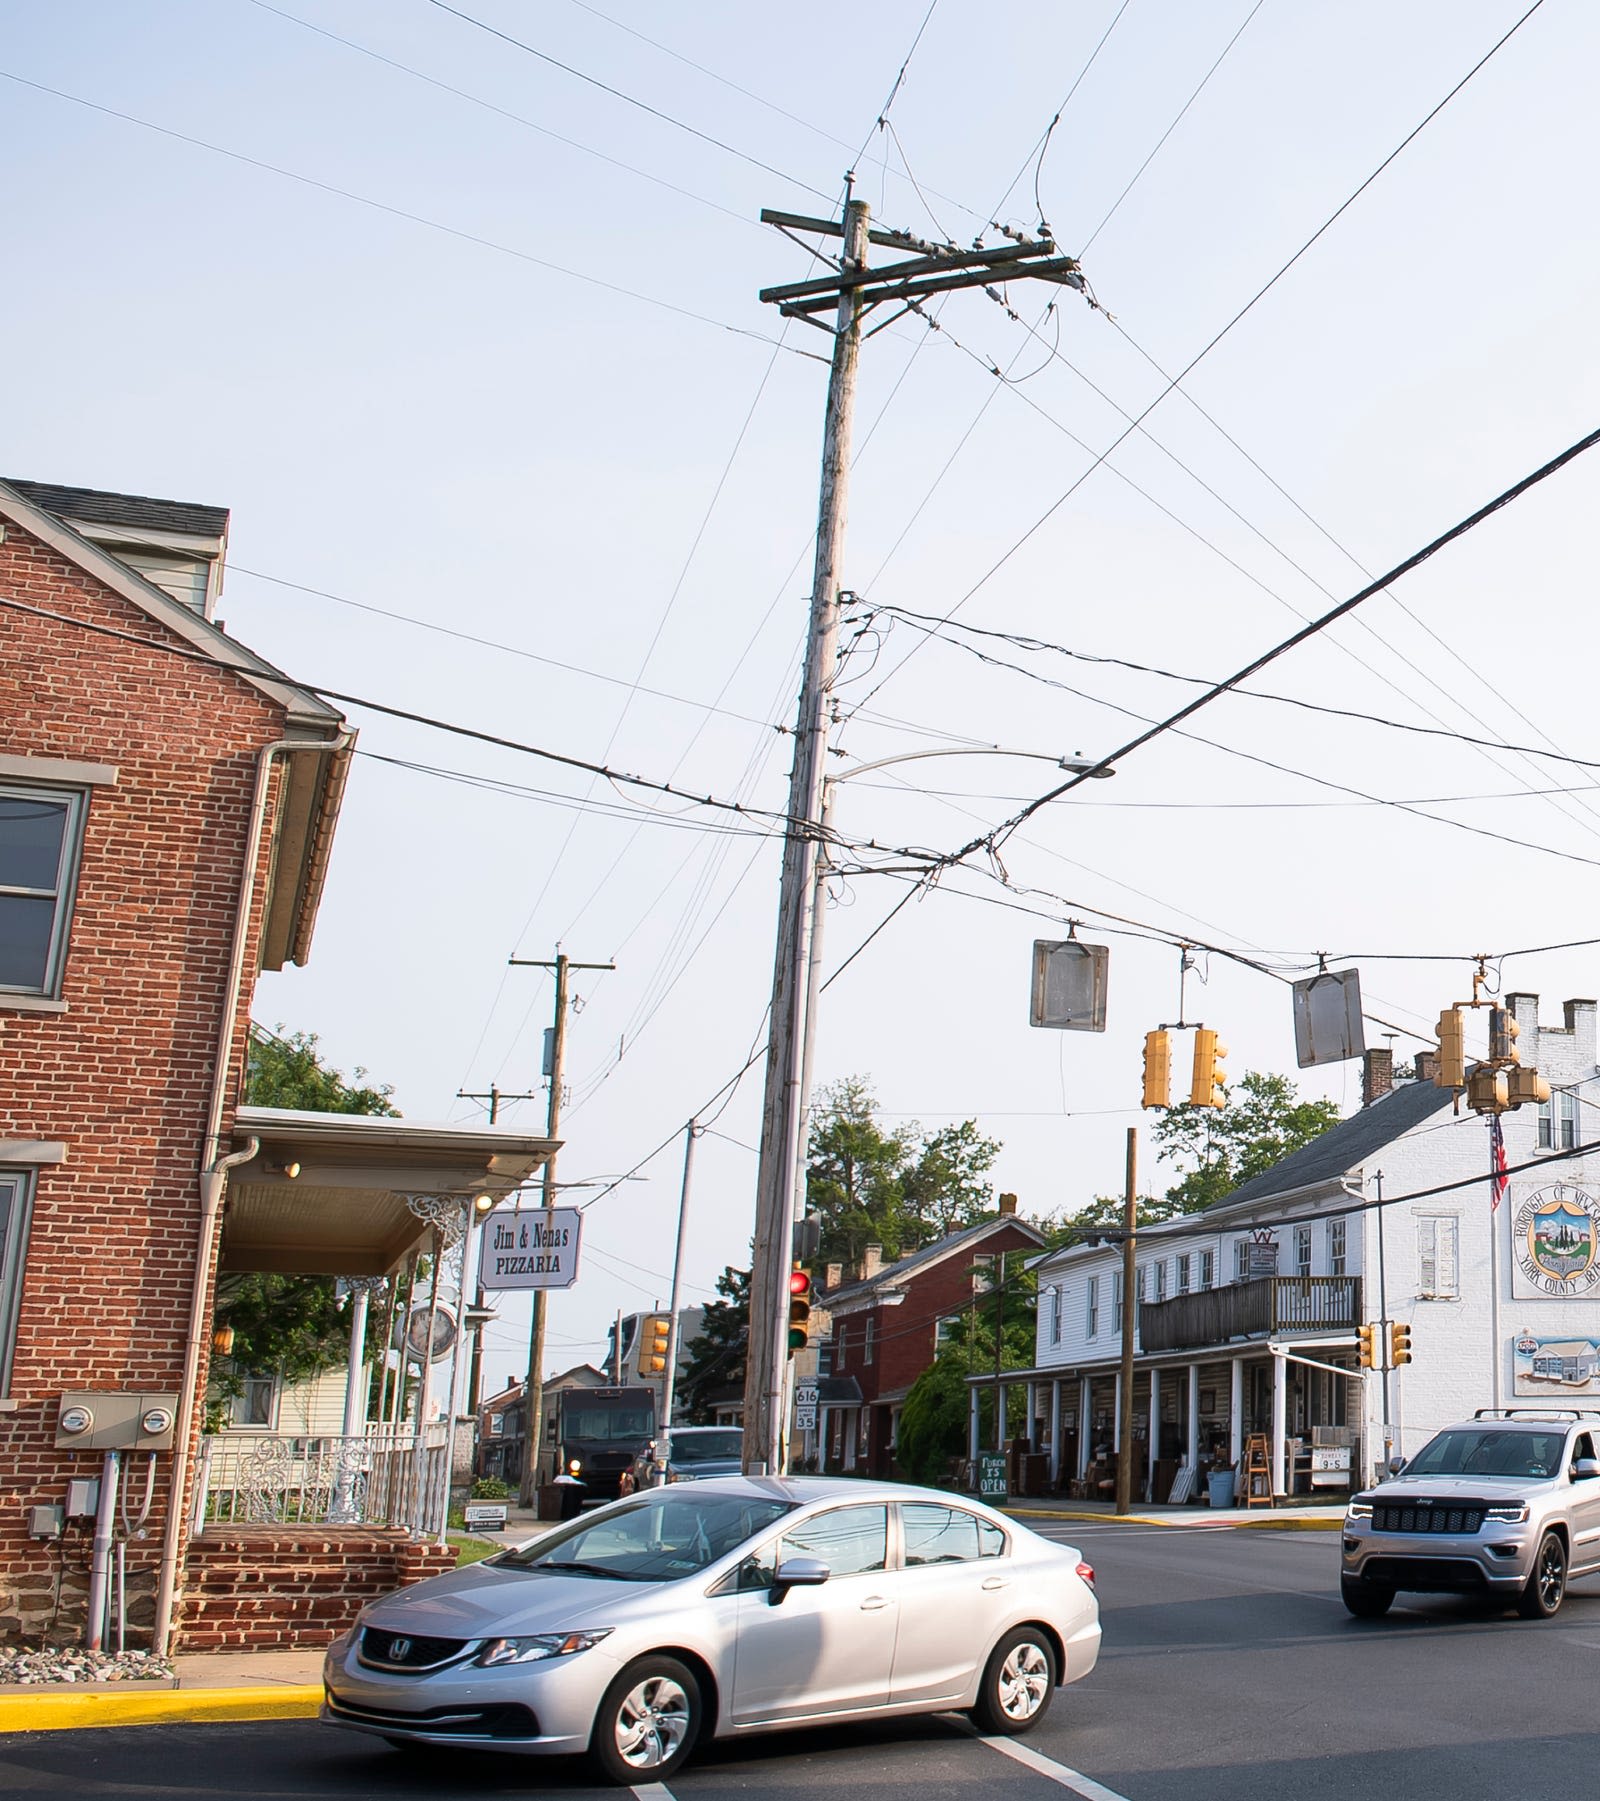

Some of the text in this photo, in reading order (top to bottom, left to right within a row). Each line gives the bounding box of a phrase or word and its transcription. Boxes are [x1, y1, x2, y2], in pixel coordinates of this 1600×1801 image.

[1515, 1193, 1545, 1237] BOROUGH
[1553, 1187, 1566, 1200] OF
[1573, 1191, 1593, 1212] NEW
[494, 1224, 515, 1250] Jim
[520, 1223, 529, 1249] &
[495, 1255, 561, 1275] PIZZARIA
[1520, 1254, 1542, 1284] YORK
[1544, 1278, 1577, 1294] COUNTY
[797, 1390, 817, 1402] 616
[797, 1418, 814, 1428] 35
[987, 1468, 1000, 1478] IS
[980, 1479, 1007, 1492] OPEN
